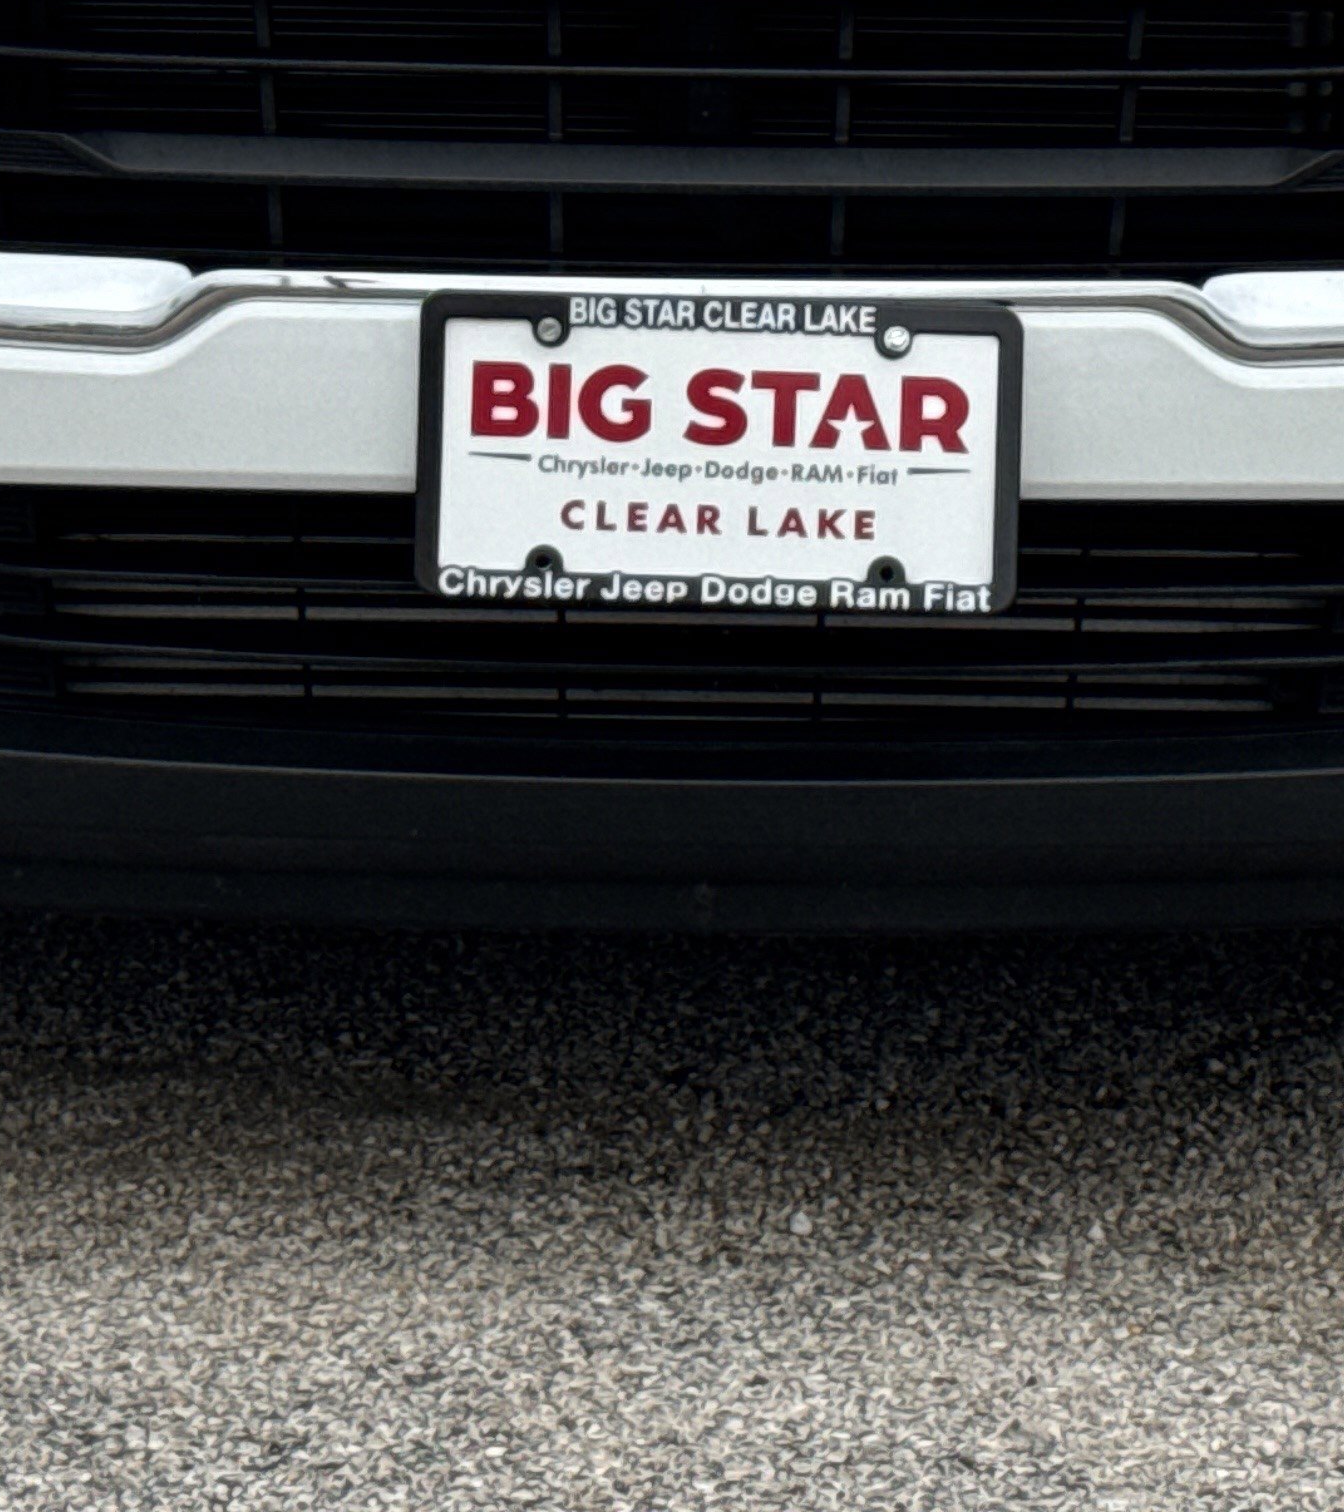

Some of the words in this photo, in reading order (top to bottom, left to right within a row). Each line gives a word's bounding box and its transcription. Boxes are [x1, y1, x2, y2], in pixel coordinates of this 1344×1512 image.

[568, 297, 617, 325] BIG
[624, 298, 696, 328] STAR
[703, 300, 797, 331] CLEAR
[804, 304, 877, 333] LAKE
[470, 360, 652, 443] BIG
[682, 368, 970, 455] STAR
[559, 499, 723, 536] CLEAR
[747, 505, 876, 541] LAKE
[437, 567, 592, 600] Chrysler
[600, 570, 689, 603] Jeep
[700, 576, 818, 607] Dodge
[829, 579, 910, 610] Ram
[922, 582, 992, 613] Fiat
